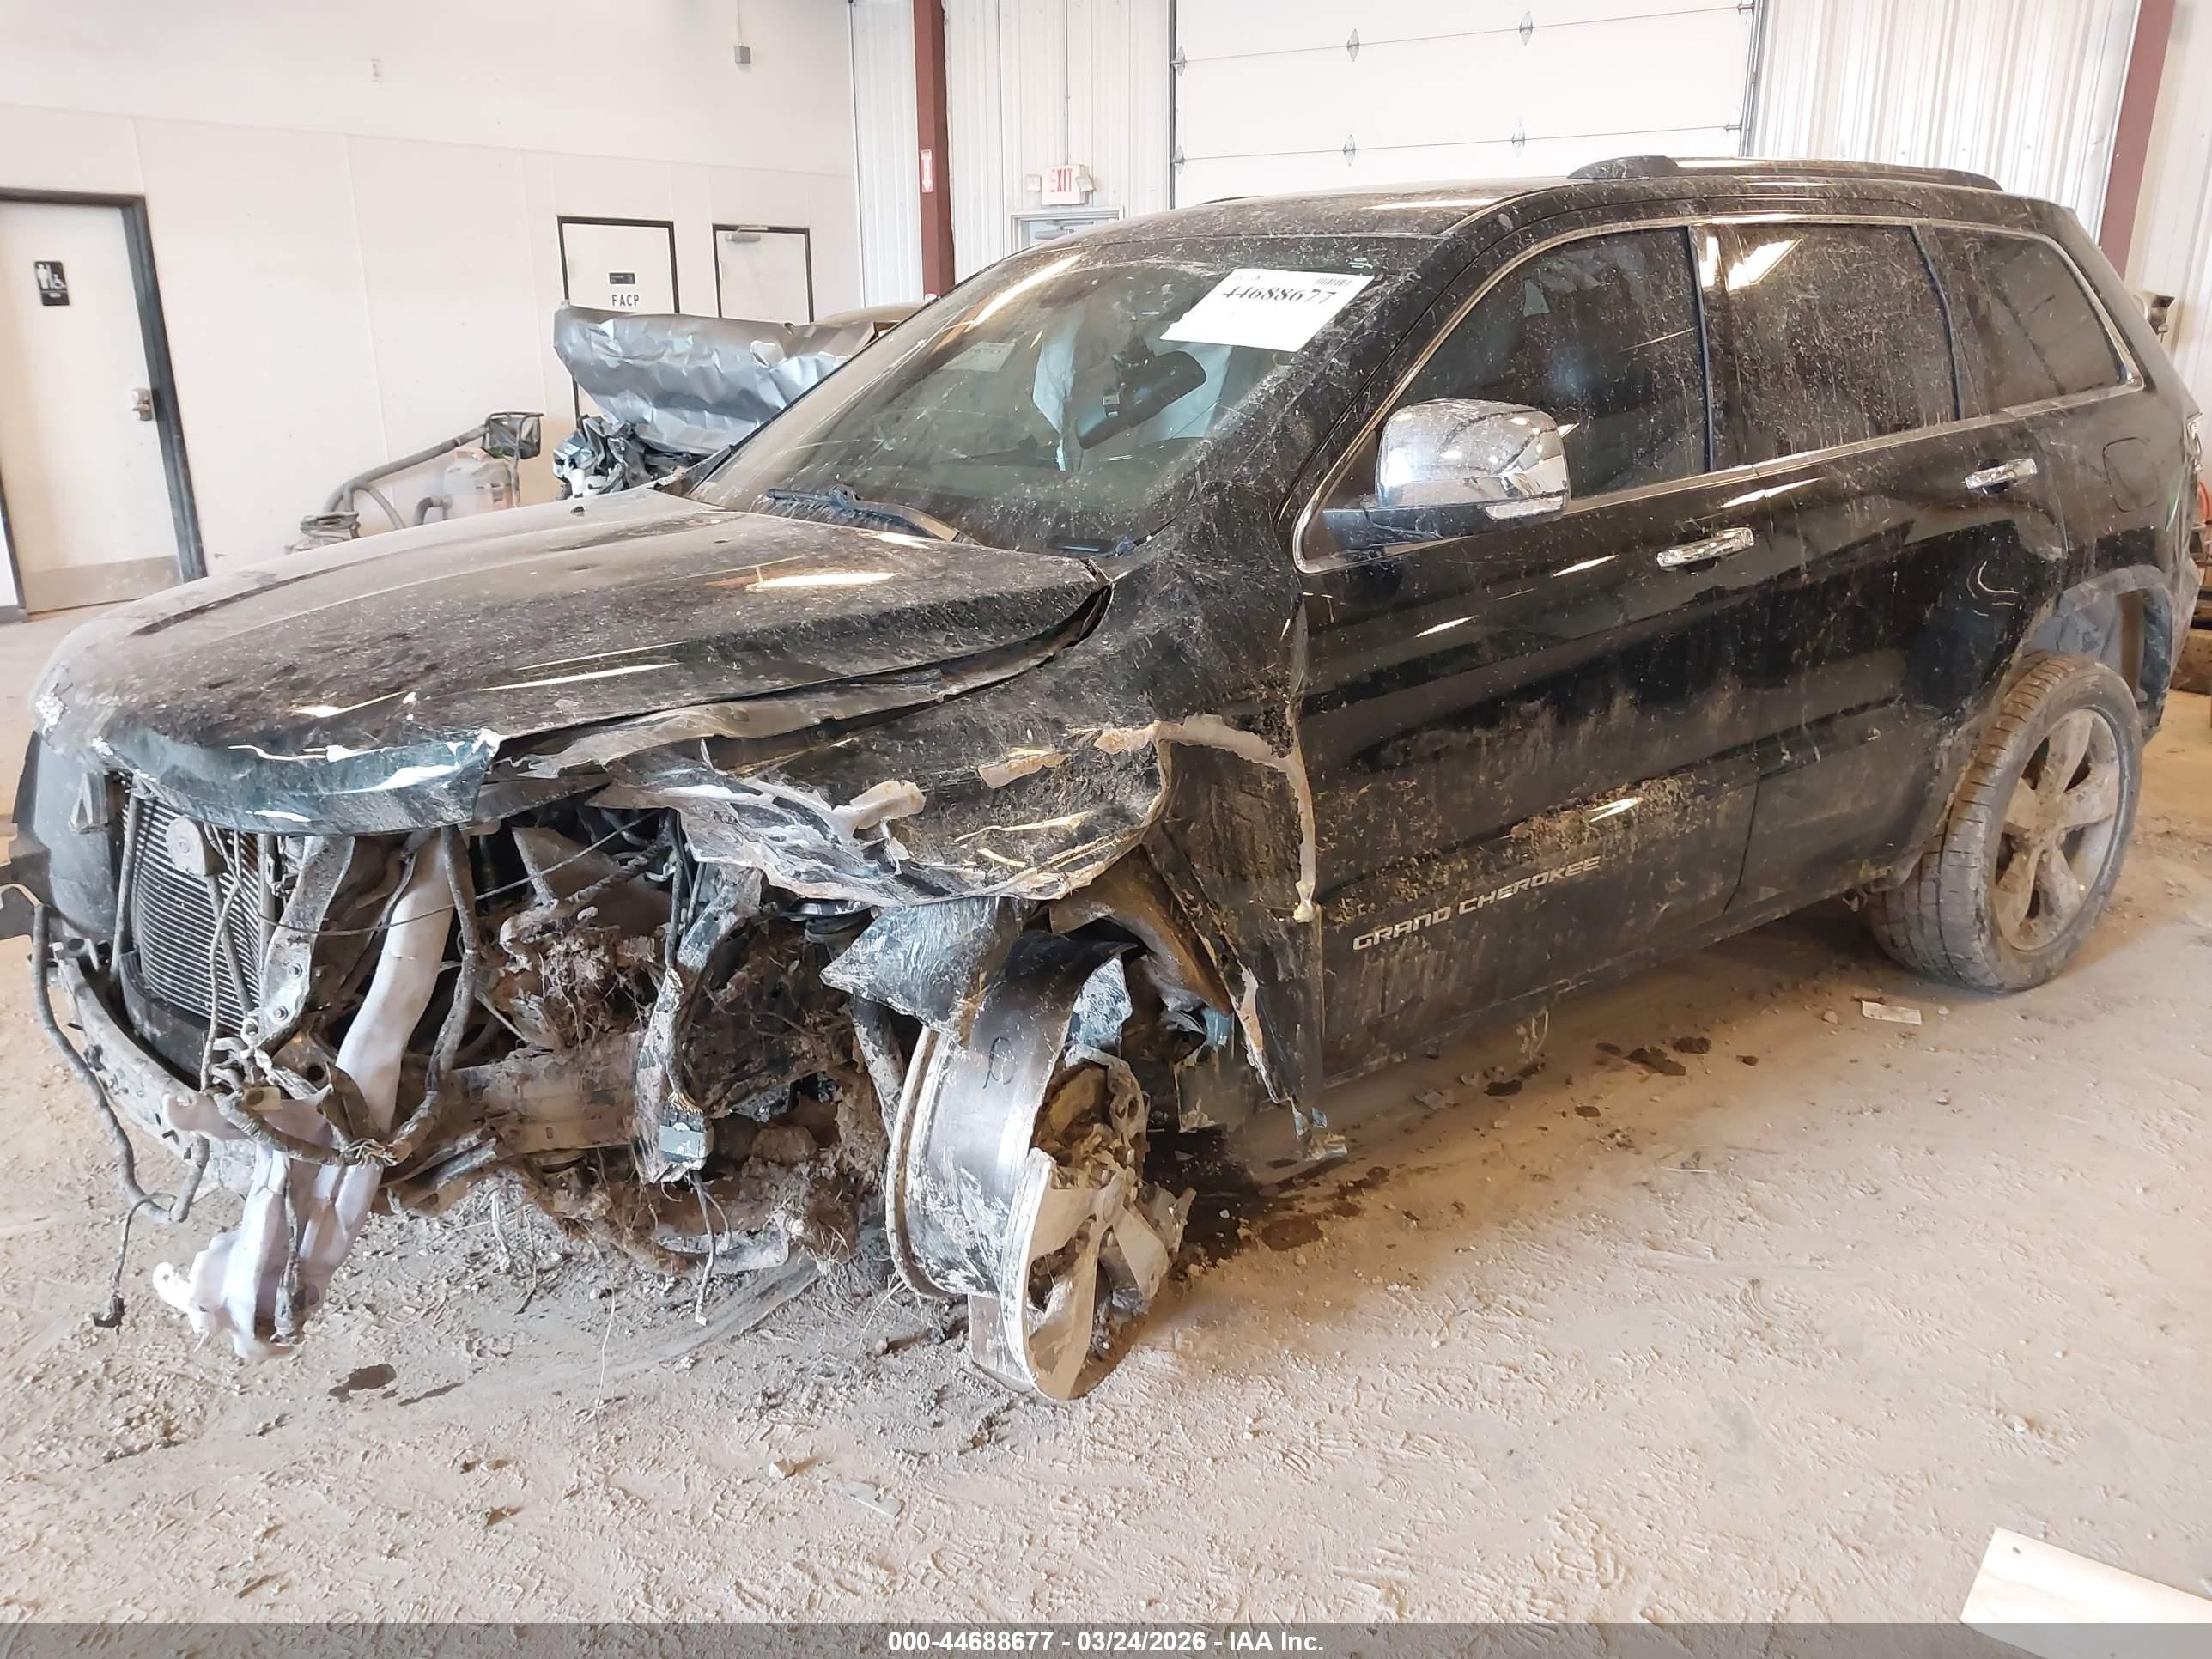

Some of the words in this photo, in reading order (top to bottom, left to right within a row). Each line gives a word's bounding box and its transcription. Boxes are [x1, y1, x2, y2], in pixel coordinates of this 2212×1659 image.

[1049, 168, 1073, 192] EXIT
[611, 294, 640, 307] FACP
[1223, 286, 1337, 304] 44688677
[1352, 906, 1451, 951] GRAND
[1459, 855, 1601, 915] CHEROKEE
